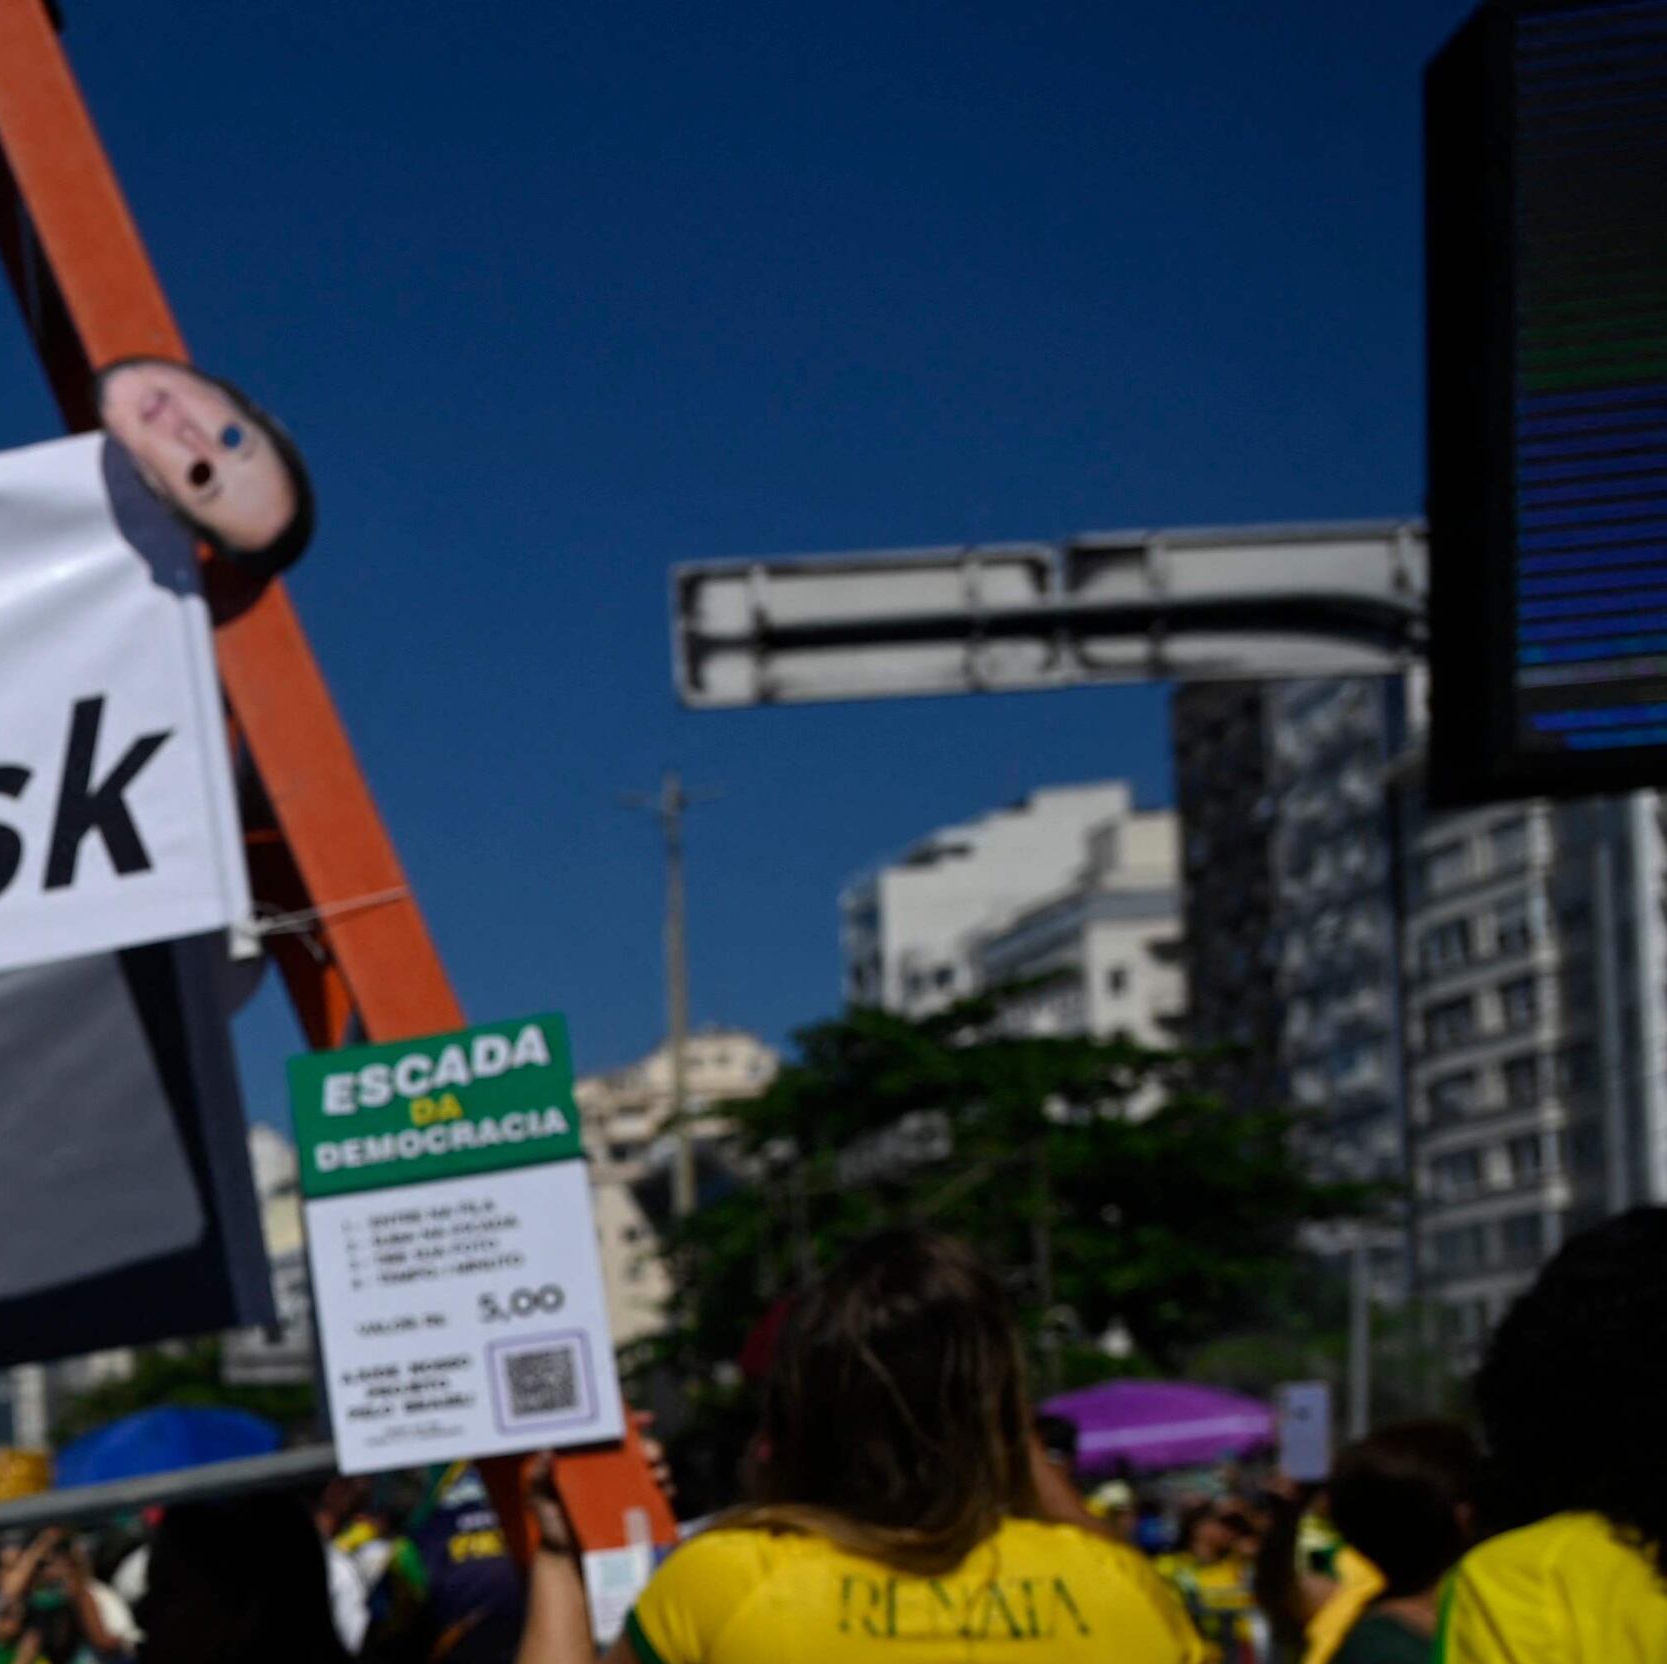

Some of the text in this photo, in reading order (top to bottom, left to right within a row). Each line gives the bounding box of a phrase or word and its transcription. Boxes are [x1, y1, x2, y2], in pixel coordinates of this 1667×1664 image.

[321, 1024, 549, 1116] ESCADA
[409, 1094, 464, 1125] DA
[314, 1107, 568, 1171] DEMOCRACIA
[478, 1284, 565, 1323] 5,00
